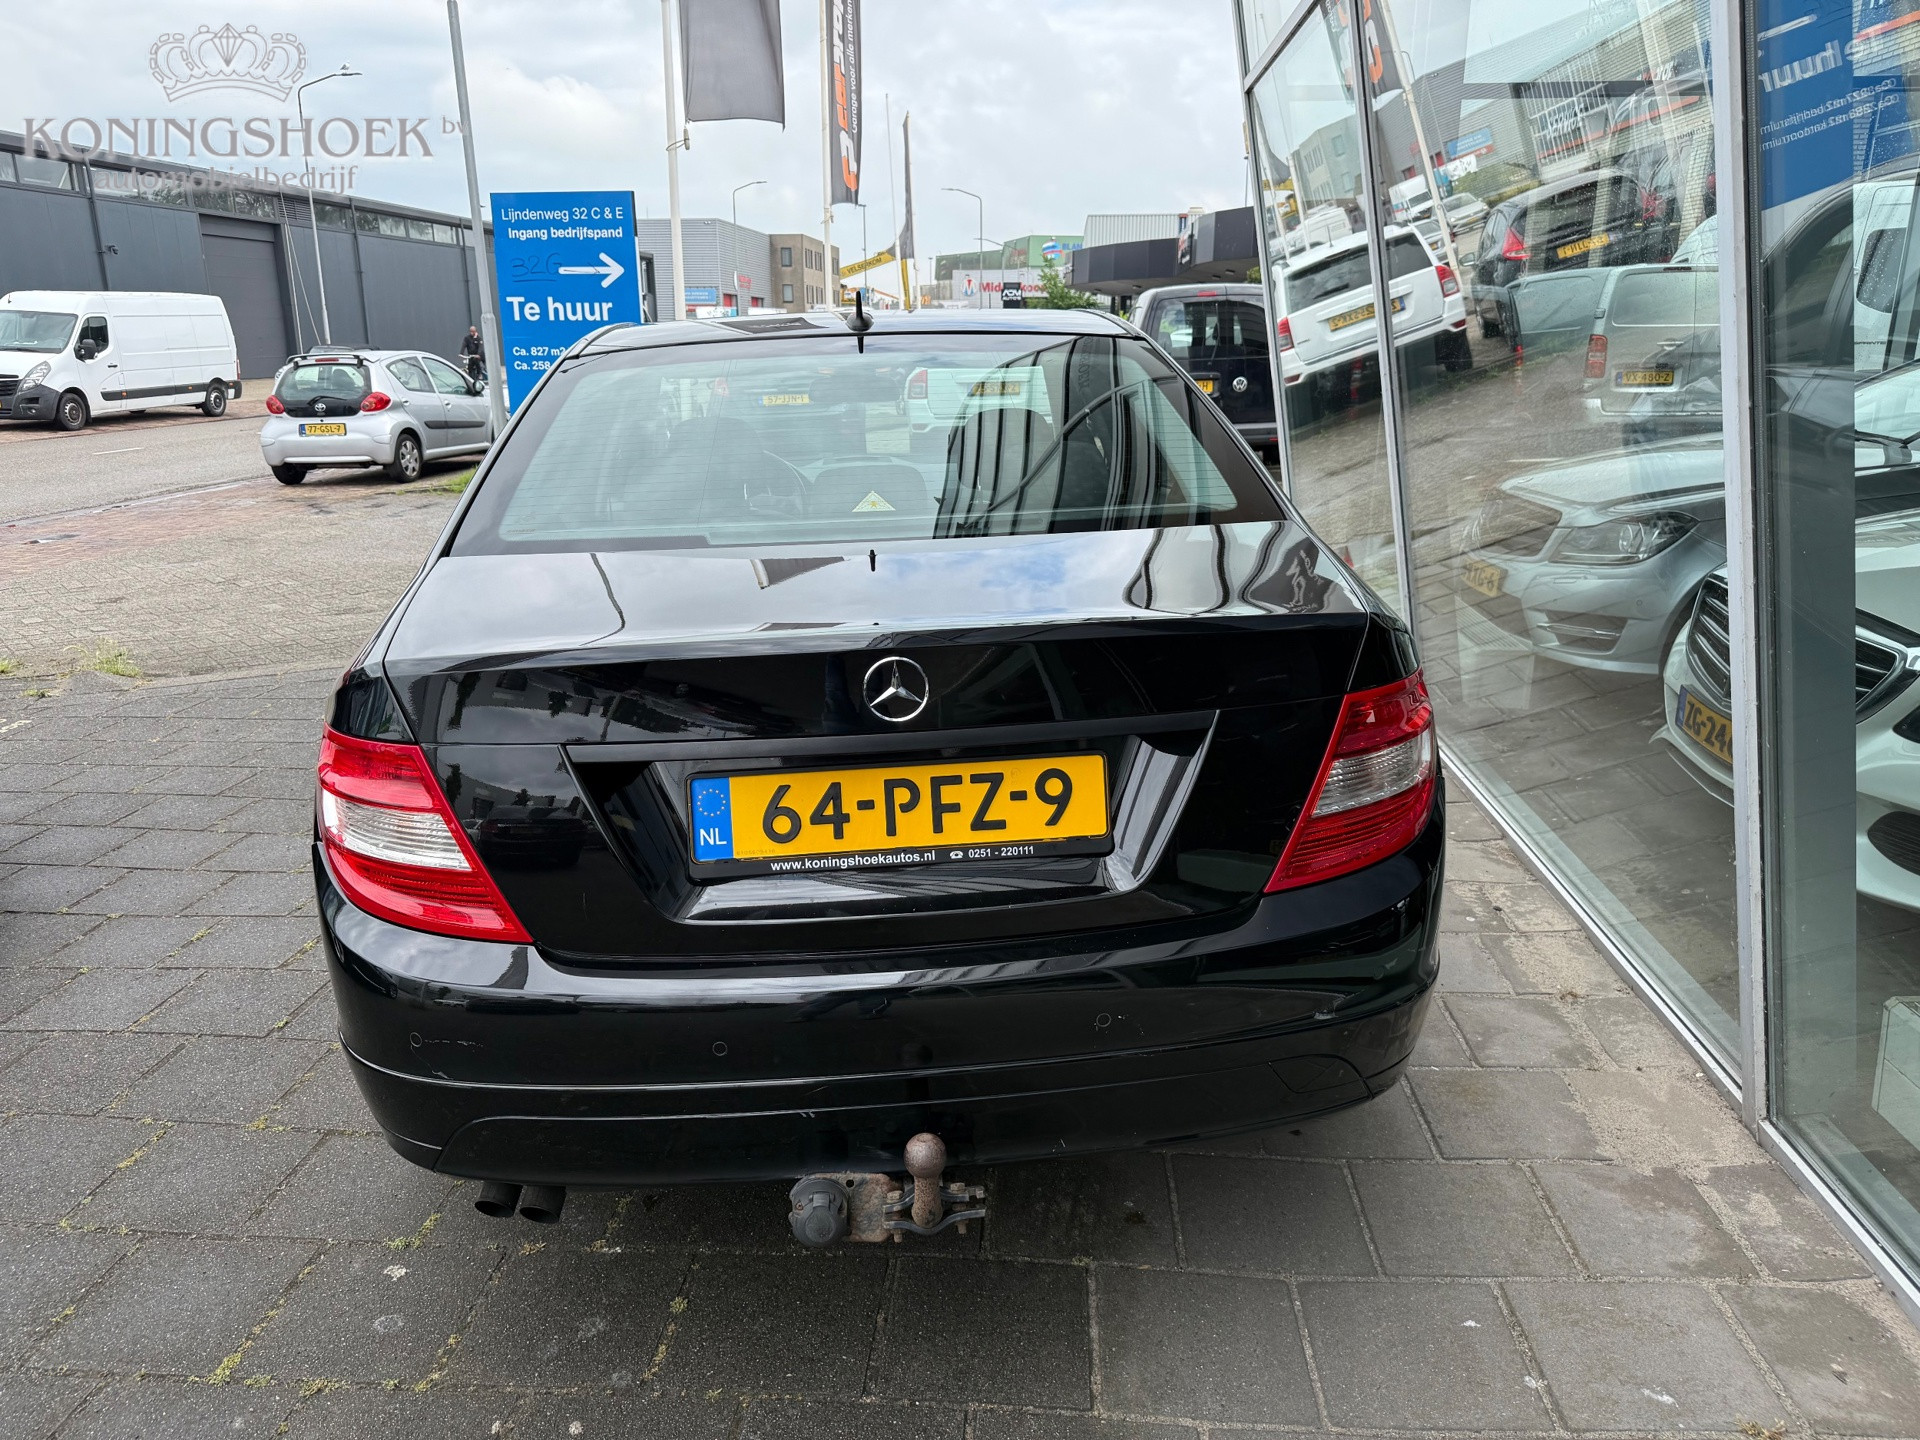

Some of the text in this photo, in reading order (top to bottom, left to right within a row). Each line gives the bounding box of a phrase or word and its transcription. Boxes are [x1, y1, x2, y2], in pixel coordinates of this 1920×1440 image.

[845, 0, 854, 41] merken
[846, 43, 855, 64] alle
[501, 207, 624, 222] Lijndenweg 32 C & E
[508, 226, 623, 241] Ingang bedrijfspand
[506, 296, 613, 321] Te huur
[512, 346, 529, 356] Ca.
[530, 346, 549, 356] 827
[514, 361, 551, 370] Ca. 258
[307, 424, 341, 434] 77-GSL-7
[762, 768, 1073, 844] 64-PFZ-9
[699, 827, 727, 847] NL
[770, 849, 936, 872] www.koningshoekautos.nl
[968, 848, 991, 859] 0251
[1000, 845, 1034, 857] 220111
